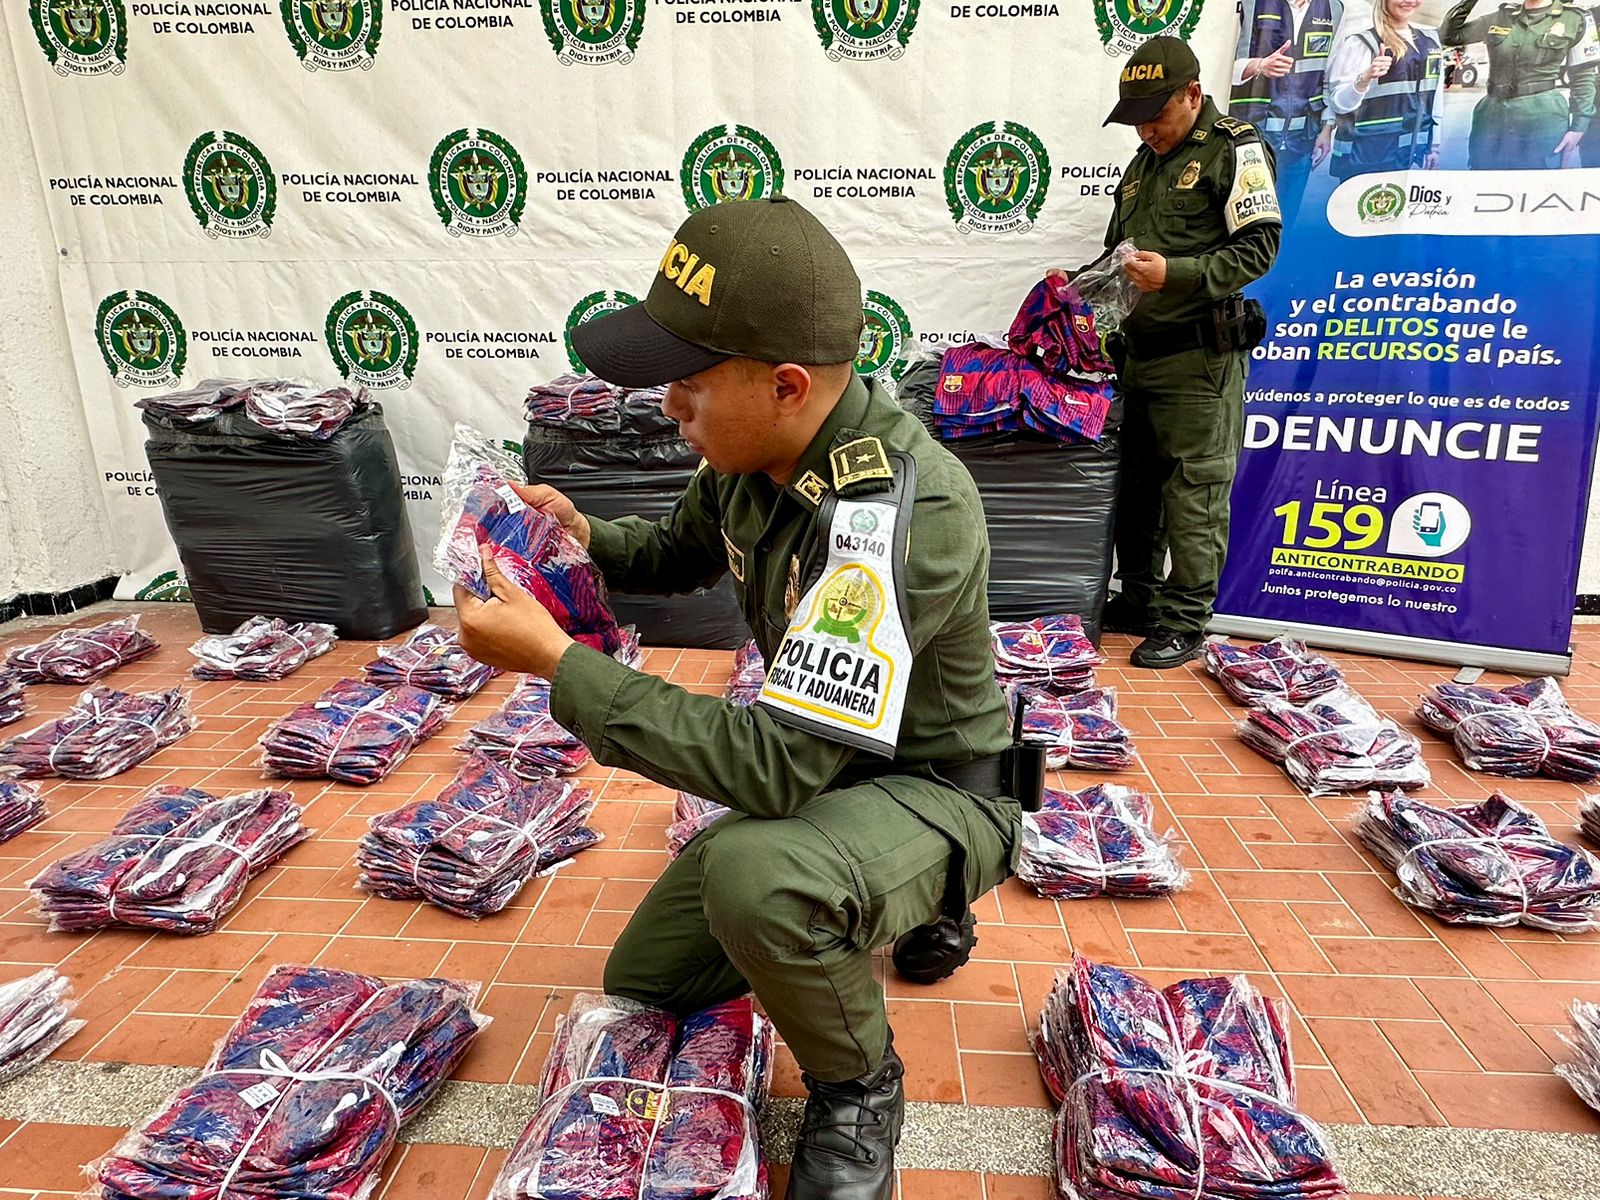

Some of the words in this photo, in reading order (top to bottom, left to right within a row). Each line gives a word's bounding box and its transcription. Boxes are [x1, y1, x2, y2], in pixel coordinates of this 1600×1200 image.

[132, 1, 191, 16] POLICÍA
[194, 3, 272, 16] NACIONAL
[950, 6, 971, 18] DE
[975, 5, 1060, 18] COLOMBIA
[412, 17, 431, 30] DE
[436, 15, 514, 29] COLOMBIA
[676, 11, 696, 24] DE
[700, 9, 782, 24] COLOMBIA
[153, 22, 172, 34] DE
[175, 22, 255, 34] COLOMBIA
[1120, 64, 1165, 83] LICIA
[536, 169, 594, 184] POLICÍA
[598, 170, 674, 183] NACIONAL
[794, 166, 852, 181] POLICÍA
[856, 168, 937, 181] NACIONAL
[1061, 163, 1122, 179] POLICÍA
[50, 175, 102, 190] POLICÍA
[105, 176, 178, 189] NACIONAL
[282, 172, 339, 186] POLICÍA
[344, 173, 419, 186] NACIONAL
[303, 191, 321, 202] DE
[325, 190, 402, 203] COLOMBIA
[557, 189, 576, 201] DE
[580, 187, 656, 201] COLOMBIA
[813, 187, 832, 199] DE
[836, 186, 916, 199] COLOMBIA
[1080, 184, 1100, 197] DE
[1409, 185, 1442, 203] Dios
[1445, 195, 1452, 205] y
[70, 195, 89, 206] DE
[91, 194, 163, 206] COLOMBIA
[1408, 202, 1450, 220] Patria
[1335, 271, 1364, 289] La
[1372, 267, 1476, 289] evasión
[1289, 299, 1305, 318] y
[1312, 294, 1336, 313] el
[1343, 293, 1517, 315] contrabando
[191, 328, 243, 342] POLICÍA
[247, 331, 318, 343] NACIONAL
[426, 329, 479, 343] POLICÍA
[484, 331, 558, 344] NACIONAL
[1275, 321, 1318, 338] son
[1325, 317, 1439, 337] DELITOS
[1445, 321, 1495, 343] que
[1502, 319, 1528, 340] le
[212, 347, 229, 358] DE
[231, 346, 302, 358] COLOMBIA
[445, 348, 463, 359] DE
[467, 347, 540, 360] COLOMBIA
[1251, 342, 1311, 361] oban
[1317, 341, 1460, 362] RECURSOS
[1465, 344, 1491, 364] al
[1498, 344, 1562, 368] país.
[1314, 392, 1324, 402] a
[1327, 391, 1404, 406] proteger
[1408, 390, 1425, 405] lo
[1428, 395, 1460, 410] que
[1463, 396, 1484, 409] es
[1488, 394, 1510, 409] de
[1515, 394, 1570, 412] todos
[1242, 414, 1543, 463] DENUNCIE
[127, 486, 142, 496] DE
[1315, 479, 1387, 503] Línea
[1273, 501, 1384, 550] 159
[835, 534, 886, 558] 043140
[1275, 553, 1459, 580] ANTICONTRABANDO
[1268, 567, 1457, 593] polfa.anticontrabando@policia.gov.co
[1261, 581, 1301, 597] Juntos
[1304, 586, 1384, 606] protegemos
[1387, 594, 1401, 607] lo
[1405, 598, 1458, 614] nuestro
[777, 639, 881, 694] POLICIA
[768, 667, 794, 692] FISCAL
[797, 674, 806, 689] Y
[804, 679, 876, 718] ADUANERA
